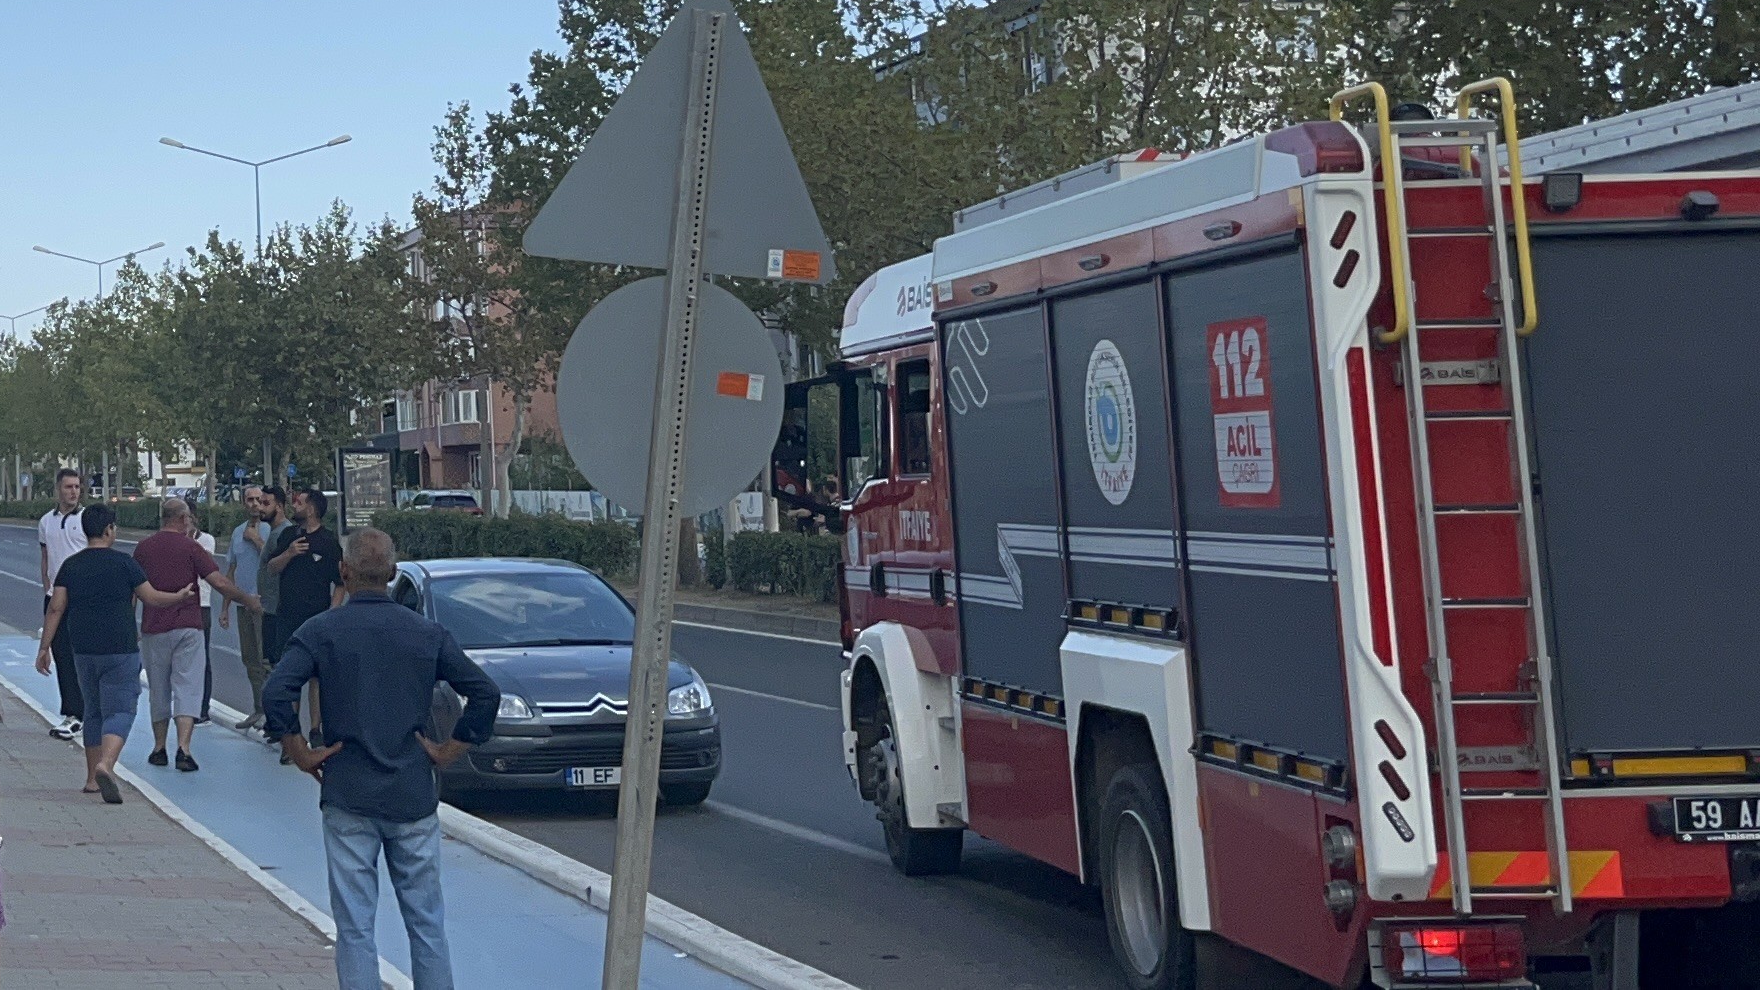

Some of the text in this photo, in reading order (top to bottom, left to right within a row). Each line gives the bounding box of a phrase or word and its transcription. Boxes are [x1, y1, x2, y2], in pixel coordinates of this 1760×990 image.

[1212, 326, 1265, 399] 112
[1227, 416, 1262, 457] ACİL
[573, 768, 614, 783] 11 EF
[1691, 801, 1722, 829] 59
